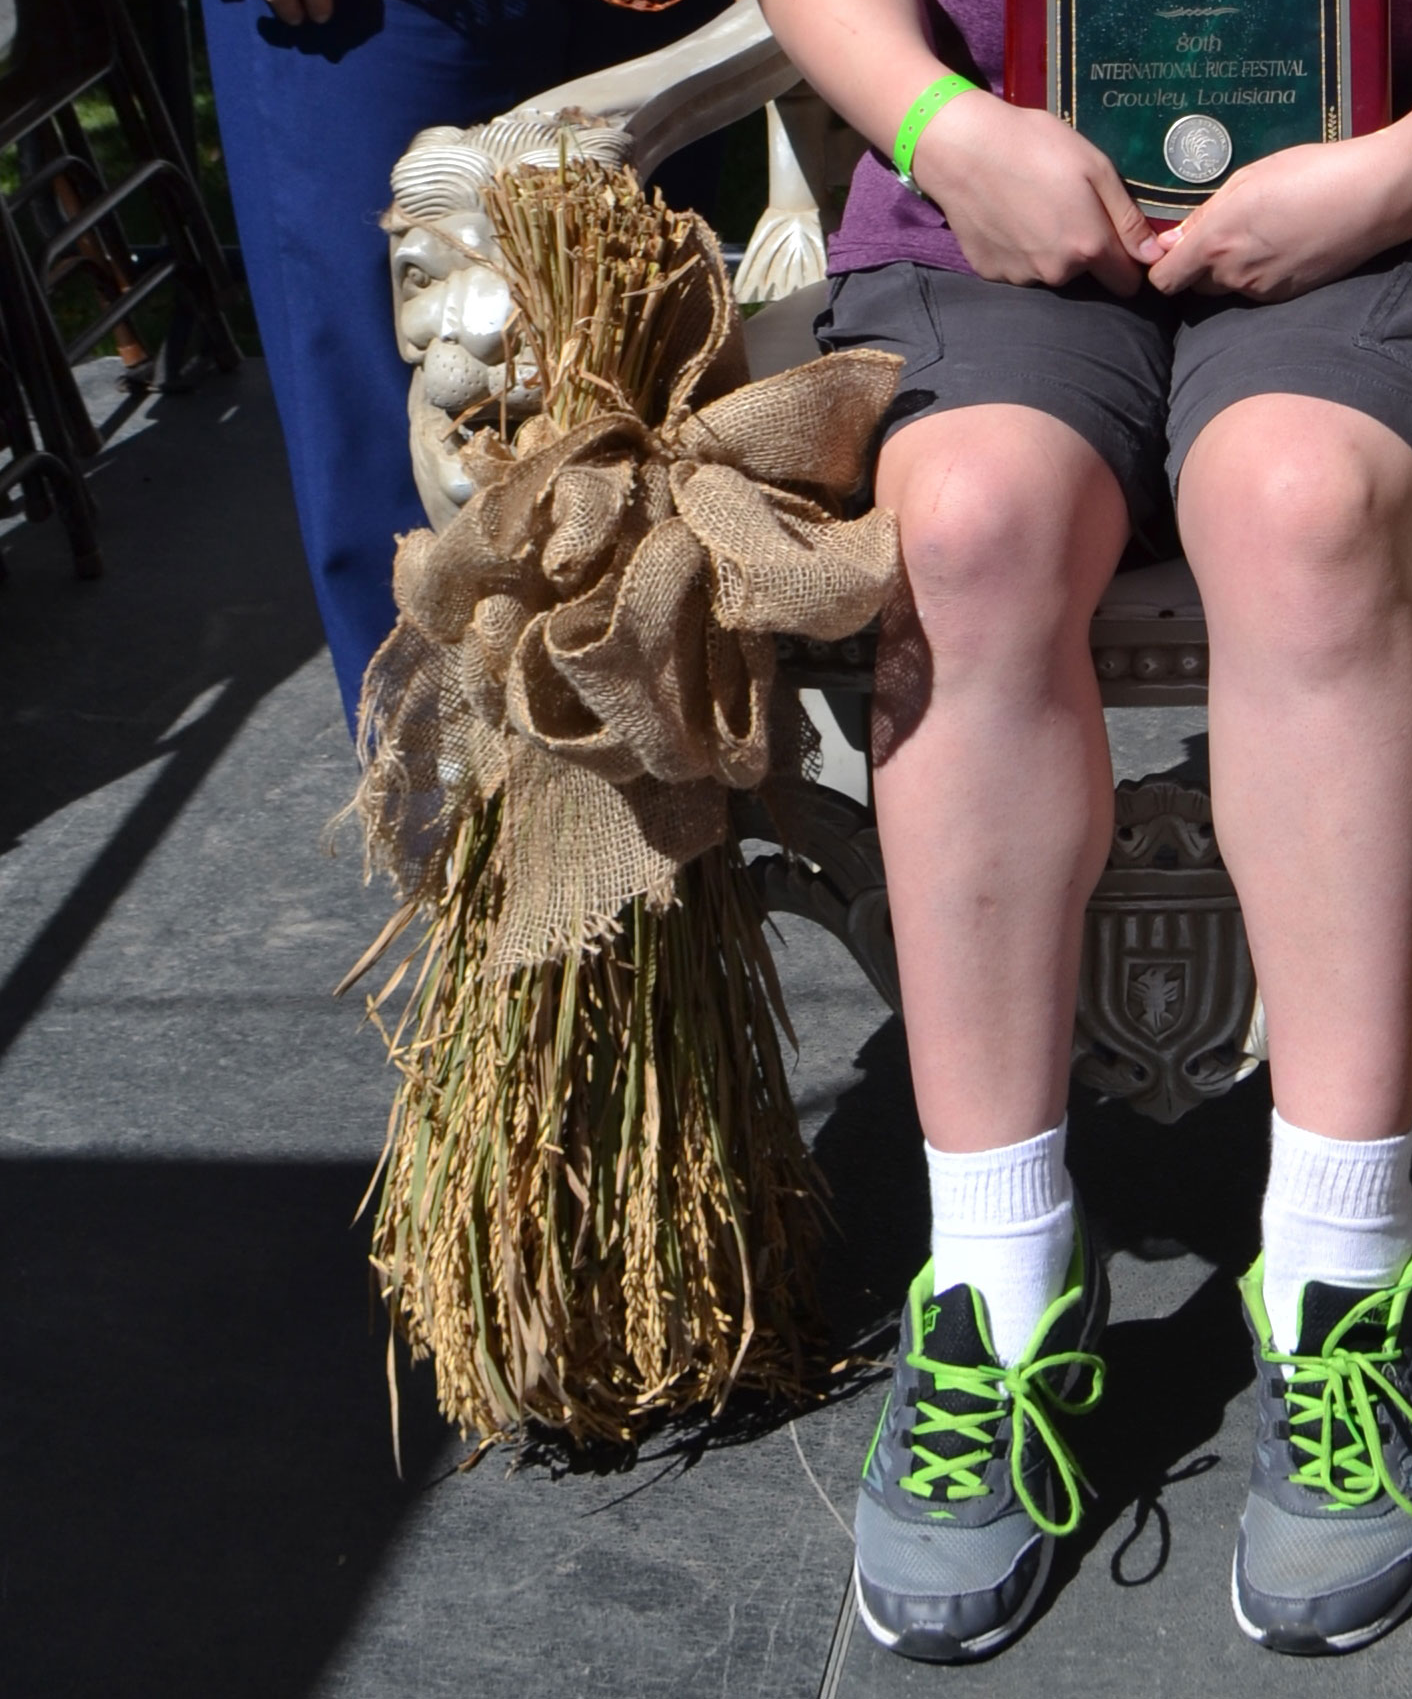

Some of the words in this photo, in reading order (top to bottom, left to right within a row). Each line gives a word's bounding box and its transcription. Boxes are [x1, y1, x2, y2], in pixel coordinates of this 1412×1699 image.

[1176, 35, 1221, 52] 80th
[1090, 62, 1201, 80] INTERNATIONAL
[1206, 61, 1237, 77] RICE
[1242, 60, 1308, 77] FESTIVAL
[1102, 89, 1188, 109] Crowley,
[1197, 88, 1296, 106] Louisiana
